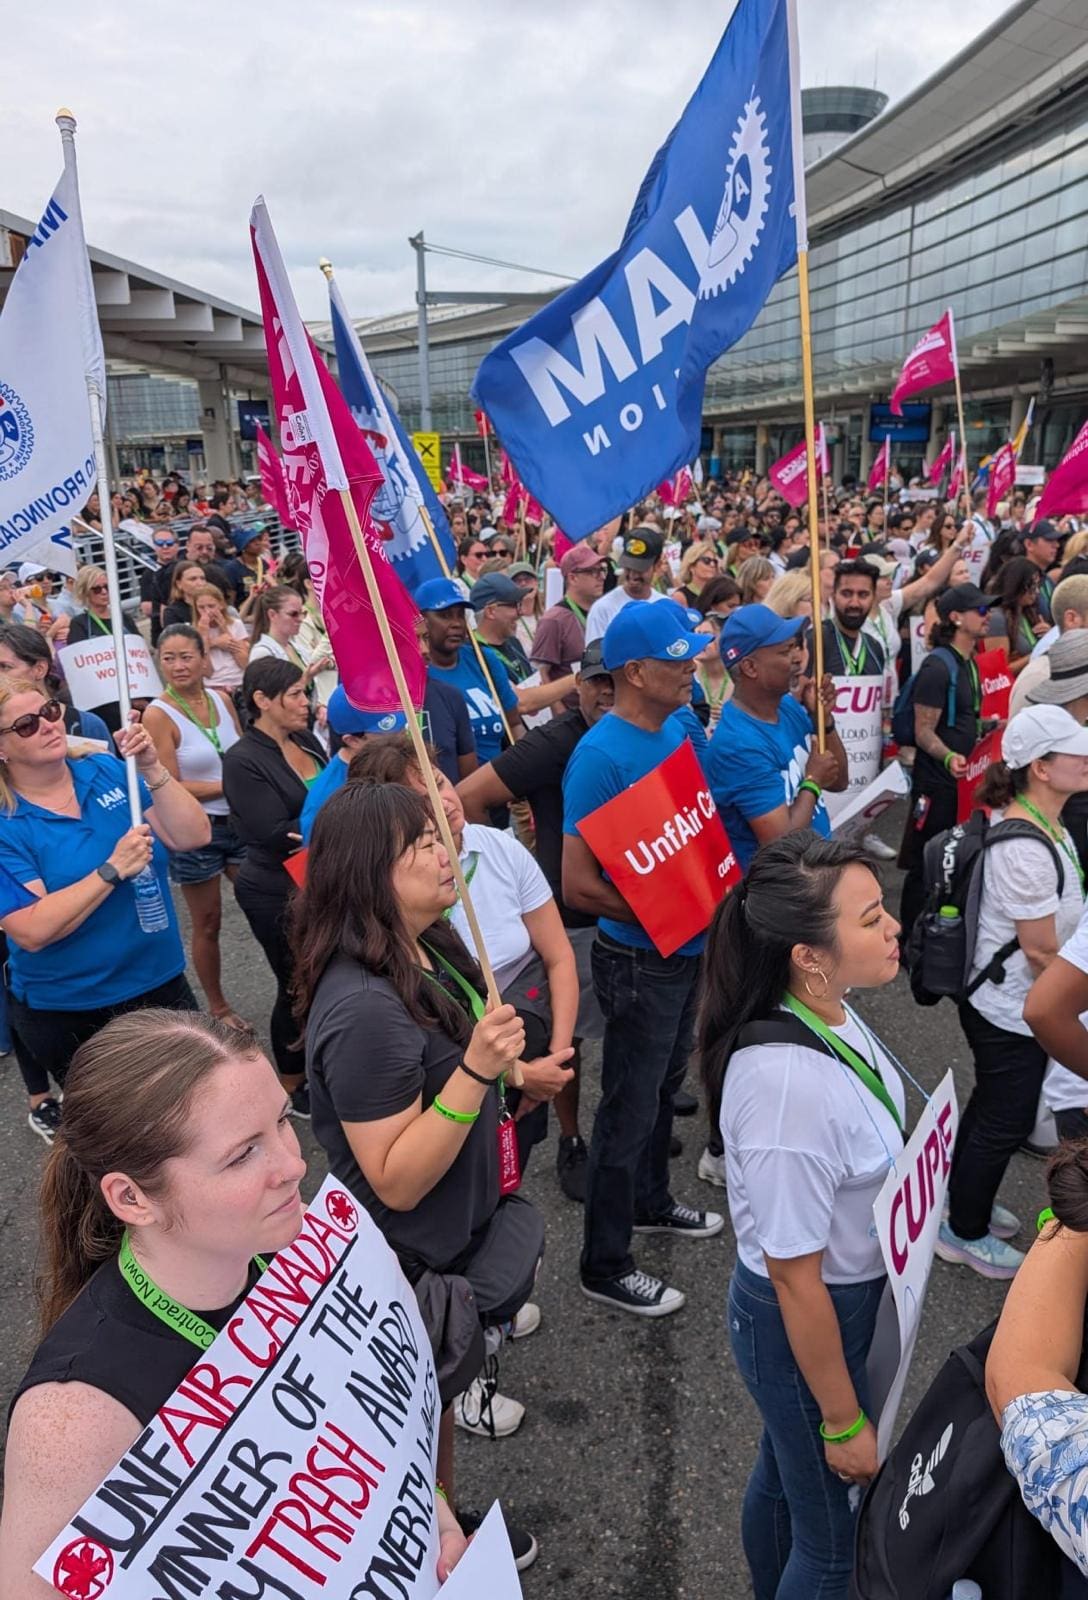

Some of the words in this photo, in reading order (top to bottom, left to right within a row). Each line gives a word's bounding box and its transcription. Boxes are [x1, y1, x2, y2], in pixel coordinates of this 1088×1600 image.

[962, 550, 984, 563] PE
[74, 646, 117, 669] Unpai
[97, 786, 126, 808] IAM
[624, 805, 704, 876] UnfAir
[890, 1101, 952, 1276] CUPE
[123, 1258, 156, 1300] Now!
[151, 1294, 217, 1348] Contract
[271, 1354, 327, 1431] OF
[310, 1269, 378, 1356] THE
[70, 1363, 253, 1552] UNFAIR
[227, 1211, 352, 1367] CANADA
[245, 1421, 386, 1587] TRASH
[345, 1300, 419, 1448] AWARD
